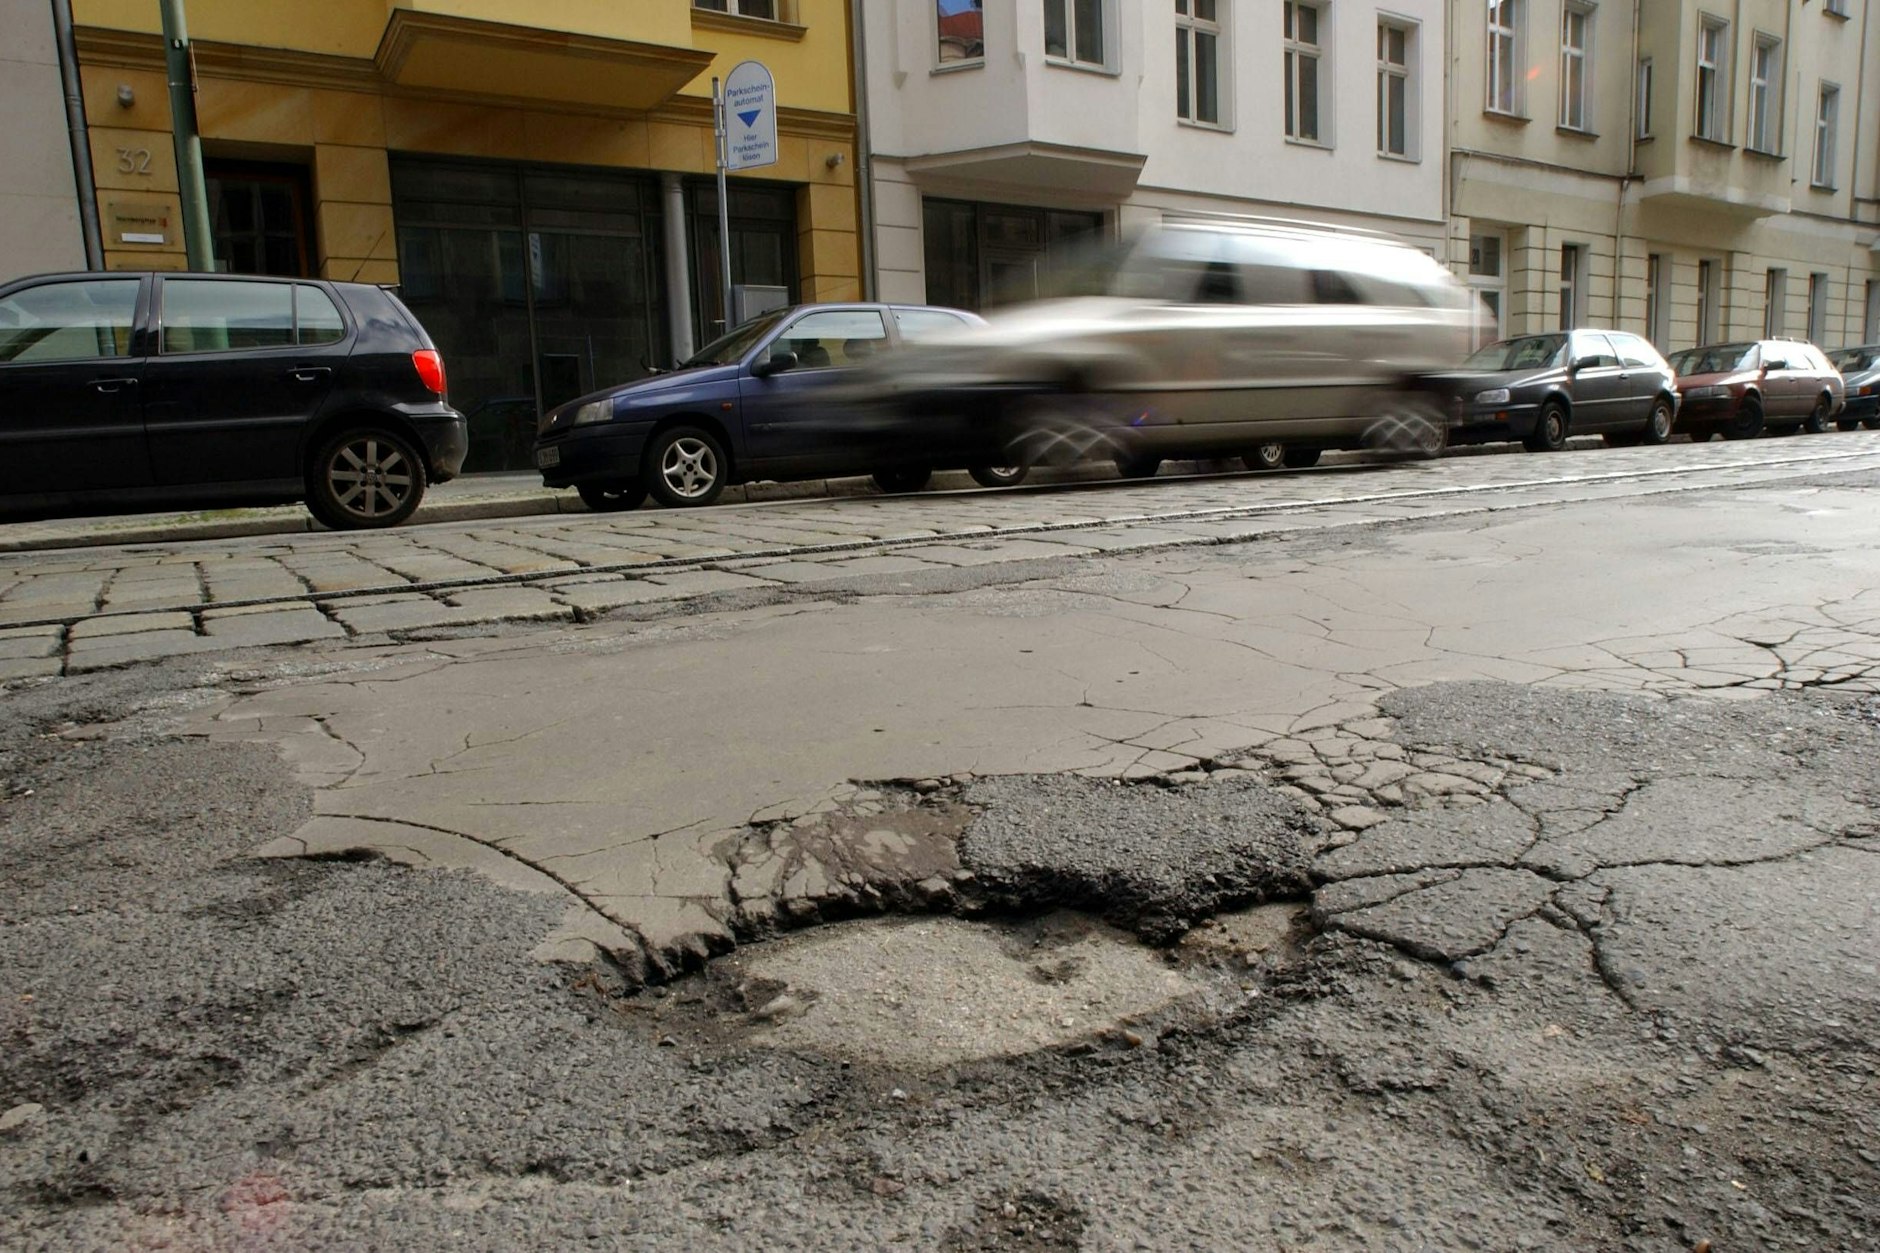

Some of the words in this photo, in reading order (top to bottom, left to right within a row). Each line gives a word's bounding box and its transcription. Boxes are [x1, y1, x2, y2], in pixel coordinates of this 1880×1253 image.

[727, 83, 770, 97] Parkschein-
[734, 94, 764, 107] automat
[743, 134, 757, 142] Hier
[733, 141, 769, 153] Parkschein
[116, 146, 153, 176] 32
